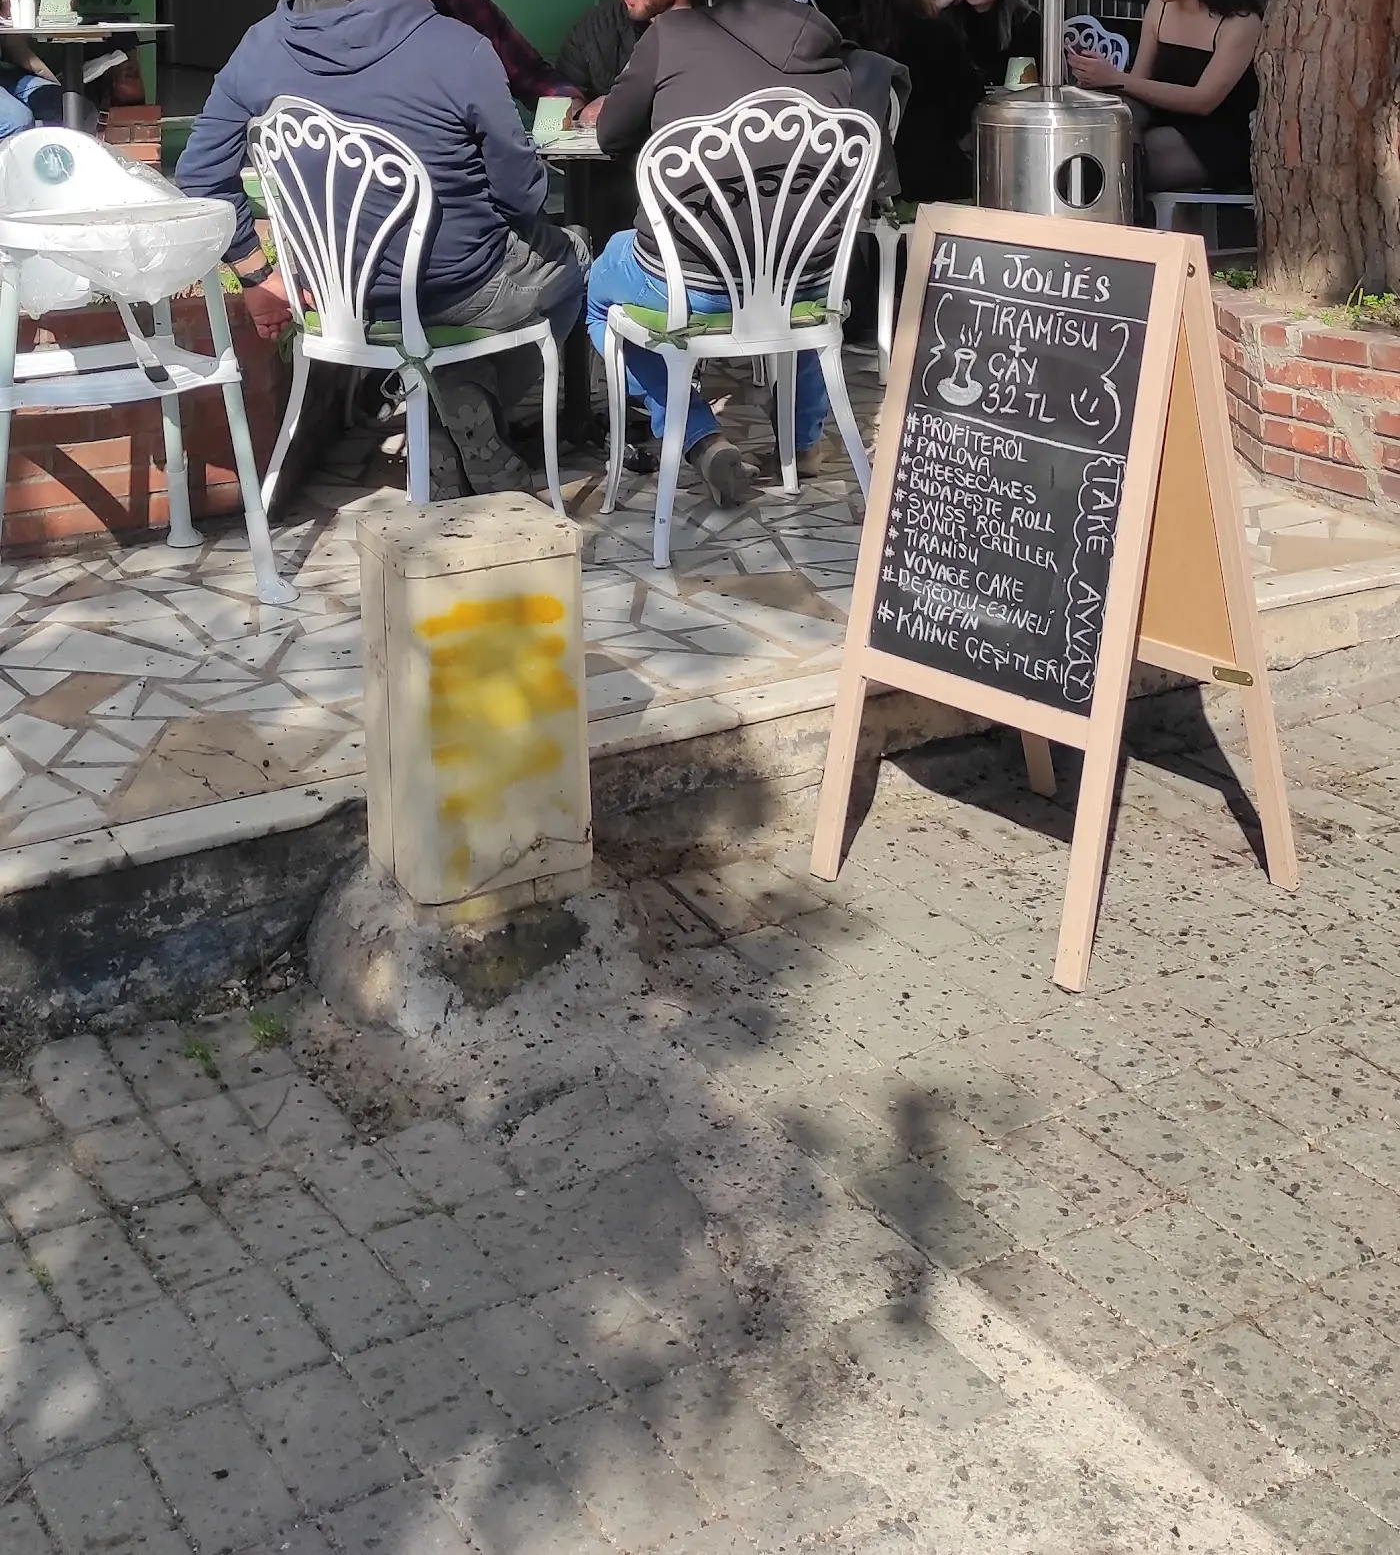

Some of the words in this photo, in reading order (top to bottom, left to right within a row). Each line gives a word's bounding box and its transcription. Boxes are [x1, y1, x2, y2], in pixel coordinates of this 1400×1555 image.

[981, 382, 1020, 414] 32
[1024, 392, 1056, 423] TL
[975, 515, 1020, 541] ROLL
[1010, 506, 1056, 534] ROLL
[1086, 464, 1121, 555] TAKE
[903, 549, 971, 589] VOYAGE
[975, 570, 1025, 602] CAKE
[1069, 580, 1102, 689] AWAY
